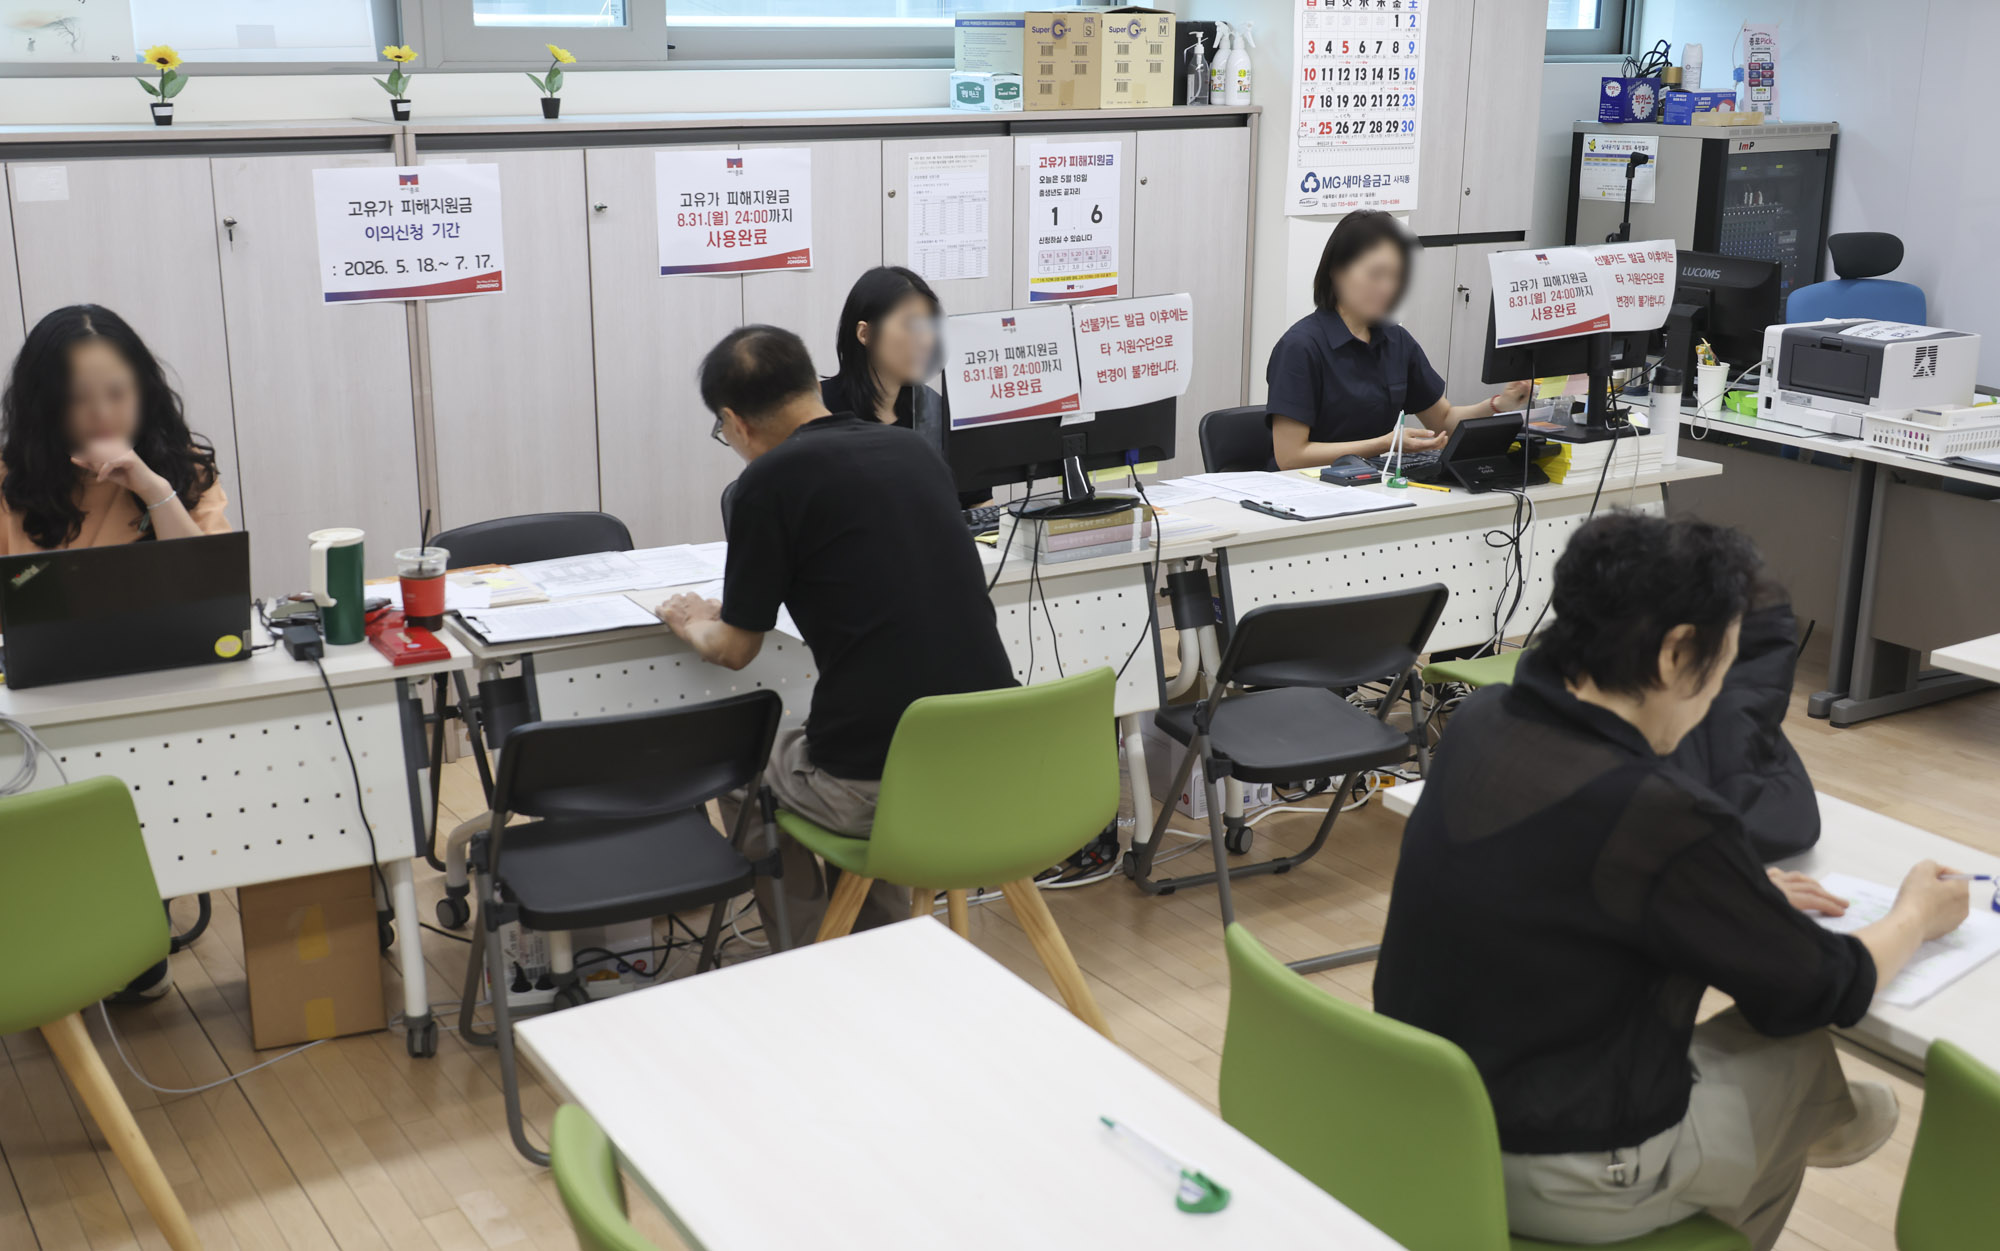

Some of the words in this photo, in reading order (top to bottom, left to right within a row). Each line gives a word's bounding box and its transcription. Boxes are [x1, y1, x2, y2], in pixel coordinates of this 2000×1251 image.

[1394, 14, 1399, 27] 1
[1409, 14, 1416, 28] 2
[1031, 26, 1050, 34] Super
[1085, 26, 1092, 36] S
[1108, 25, 1127, 34] Super
[1159, 25, 1167, 35] M
[1308, 40, 1315, 54] 3
[1325, 41, 1332, 54] 4
[1342, 41, 1349, 54] 5
[1359, 41, 1366, 54] 6
[1375, 41, 1383, 54] 7
[1392, 41, 1399, 54] 8
[1408, 41, 1415, 54] 9
[1304, 68, 1316, 81] 10
[1322, 68, 1333, 81] 11
[1338, 68, 1350, 81] 12
[1355, 68, 1367, 81] 13
[1372, 68, 1384, 80] 14
[1388, 68, 1400, 80] 15
[1404, 68, 1416, 80] 16
[1302, 95, 1315, 108] 17
[1320, 95, 1332, 108] 18
[1336, 95, 1349, 108] 19
[1353, 95, 1367, 107] 20
[1371, 94, 1383, 107] 21
[1386, 94, 1400, 107] 22
[1402, 94, 1416, 107] 23
[1640, 106, 1645, 115] F
[1319, 122, 1332, 135] 25
[1335, 121, 1349, 134] 26
[1352, 121, 1366, 134] 27
[1369, 121, 1383, 133] 28
[1385, 120, 1399, 133] 29
[1401, 120, 1414, 133] 30
[1039, 156, 1066, 168] 고유가
[1069, 154, 1114, 167] 피해지원금
[1039, 175, 1058, 184] 오늘은
[1060, 174, 1072, 183] 5월
[1073, 174, 1088, 182] 18일
[1393, 175, 1411, 184] 사직동
[680, 192, 719, 207] 고유가
[727, 189, 790, 206] 피해지원금
[348, 200, 393, 217] 고유가
[401, 197, 472, 215] 피해지원금
[735, 208, 793, 224] 24:00까지
[1051, 206, 1058, 226] 1
[1091, 204, 1103, 224] 6
[365, 223, 424, 241] 이의신청
[432, 222, 460, 239] 기간
[706, 228, 768, 248] 사용완료
[1039, 236, 1062, 245] 신청하실
[1063, 235, 1069, 243] 수
[1070, 234, 1092, 242] 있습니다
[344, 260, 388, 276] 2026.
[396, 259, 409, 273] 5.
[455, 256, 468, 270] 7.
[475, 254, 494, 269] 17.
[1594, 253, 1627, 266] 선불카드
[1628, 252, 1645, 263] 발급
[1647, 251, 1675, 263] 이후에는
[1615, 273, 1625, 285] 타
[1628, 272, 1665, 285] 지원수단으로
[1682, 266, 1721, 279] LUCOMS
[1510, 279, 1539, 293] 고유가
[1543, 272, 1588, 288] 피해지원금
[1550, 285, 1594, 300] 24:00까지
[1616, 295, 1636, 308] 변경이
[1531, 302, 1577, 322] 사용완료
[1079, 315, 1121, 333] 선불카드
[1124, 313, 1145, 328] 발급
[1149, 308, 1189, 324] 이후에는
[1100, 342, 1111, 357] 타
[1116, 334, 1173, 353] 지원수단으로
[964, 349, 999, 365] 고유가
[1005, 342, 1058, 360] 피해지원금
[1013, 359, 1062, 377] 24:00까지
[1097, 366, 1127, 384] 변경이
[1132, 360, 1179, 379] 불가합니다.
[990, 378, 1042, 400] 사용완료
